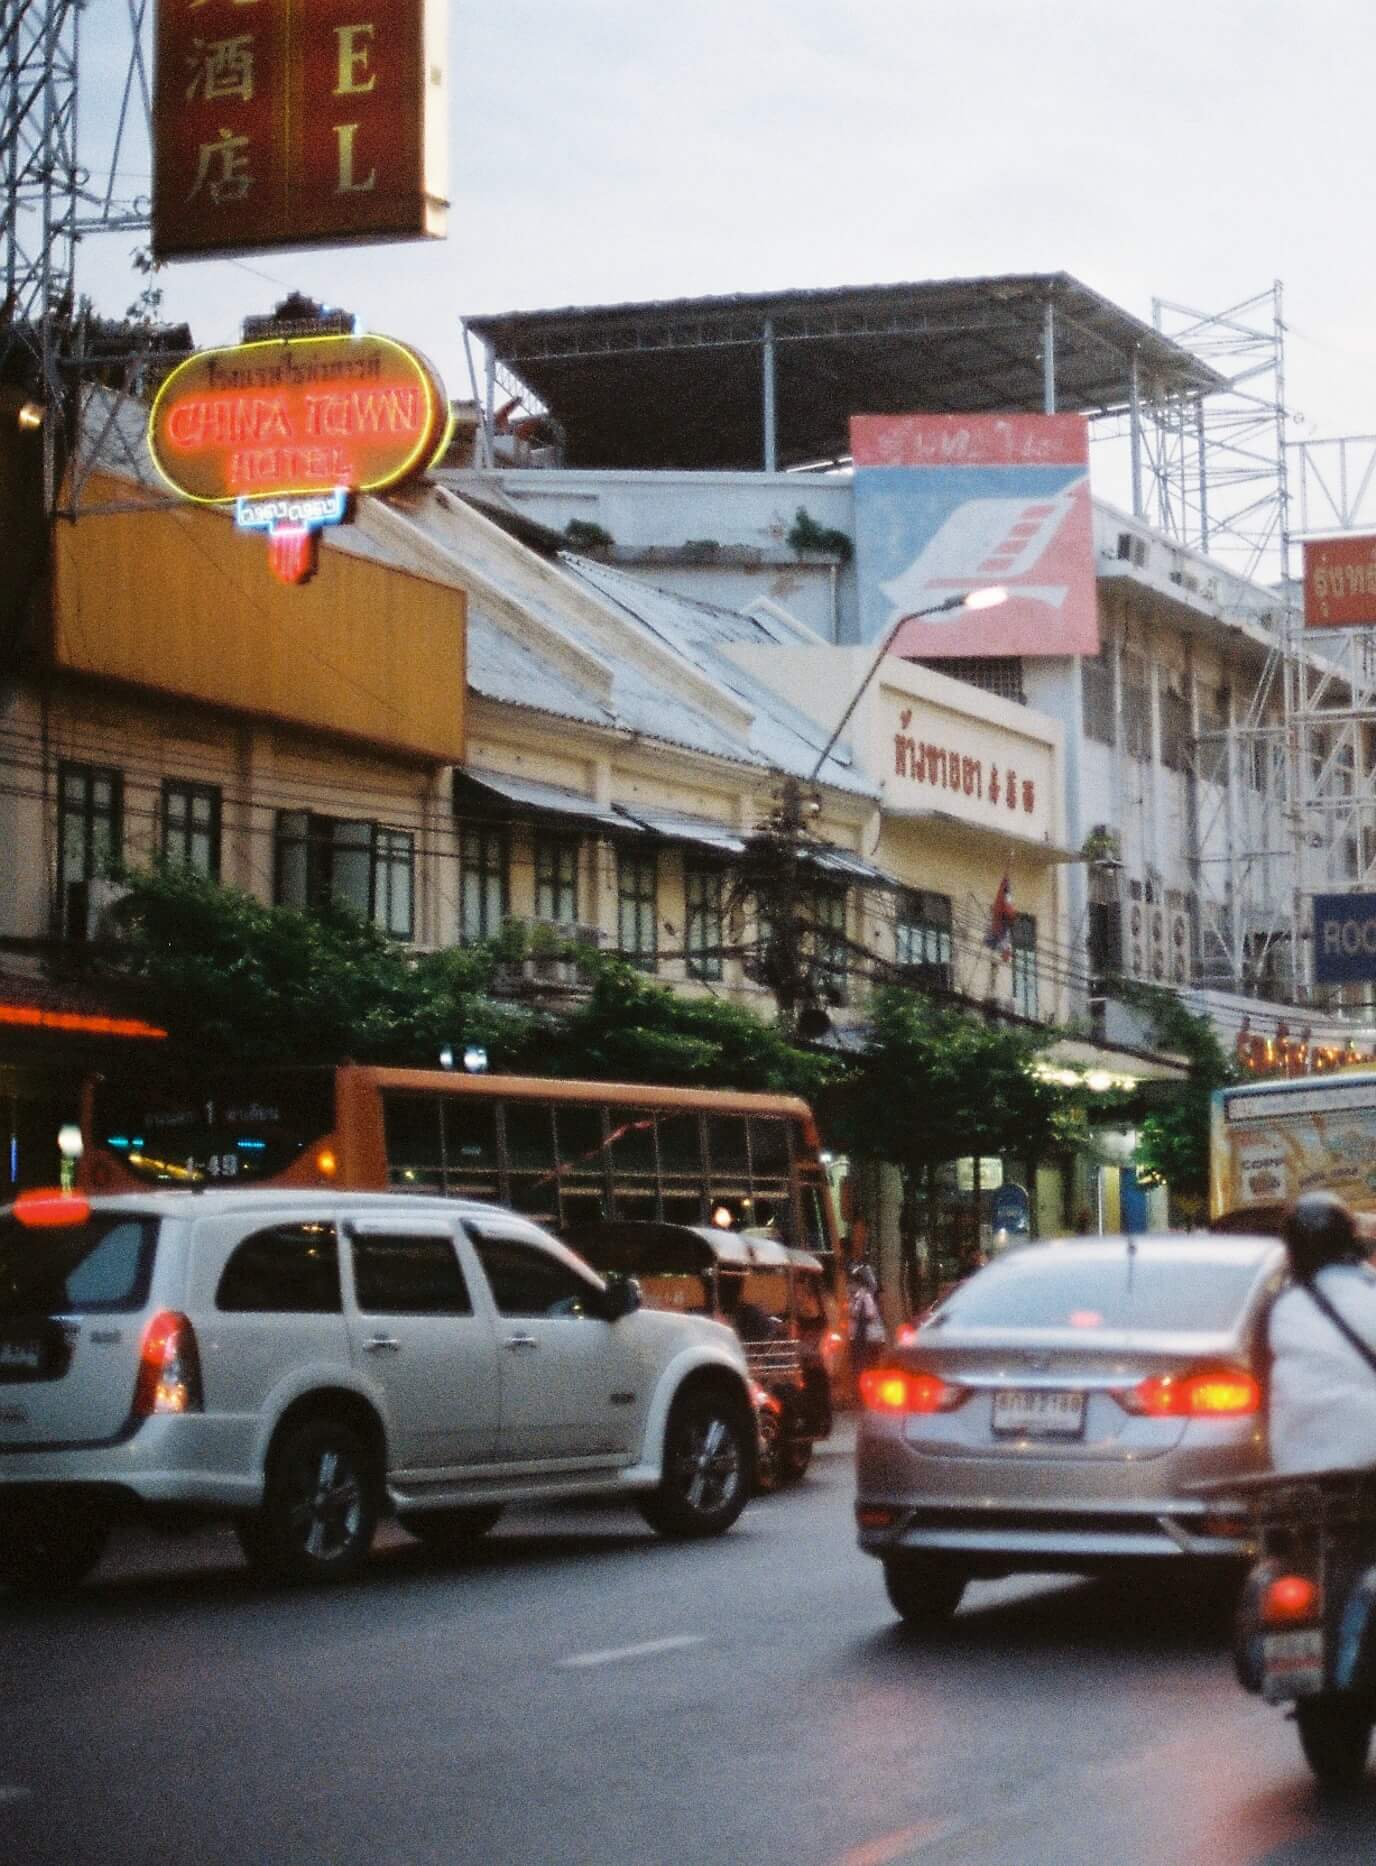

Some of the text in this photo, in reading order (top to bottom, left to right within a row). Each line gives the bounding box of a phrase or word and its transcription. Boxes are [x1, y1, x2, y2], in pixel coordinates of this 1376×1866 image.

[186, 0, 256, 204] 酒店
[168, 388, 418, 449] CHINA TOWN
[231, 447, 351, 485] HOTEL
